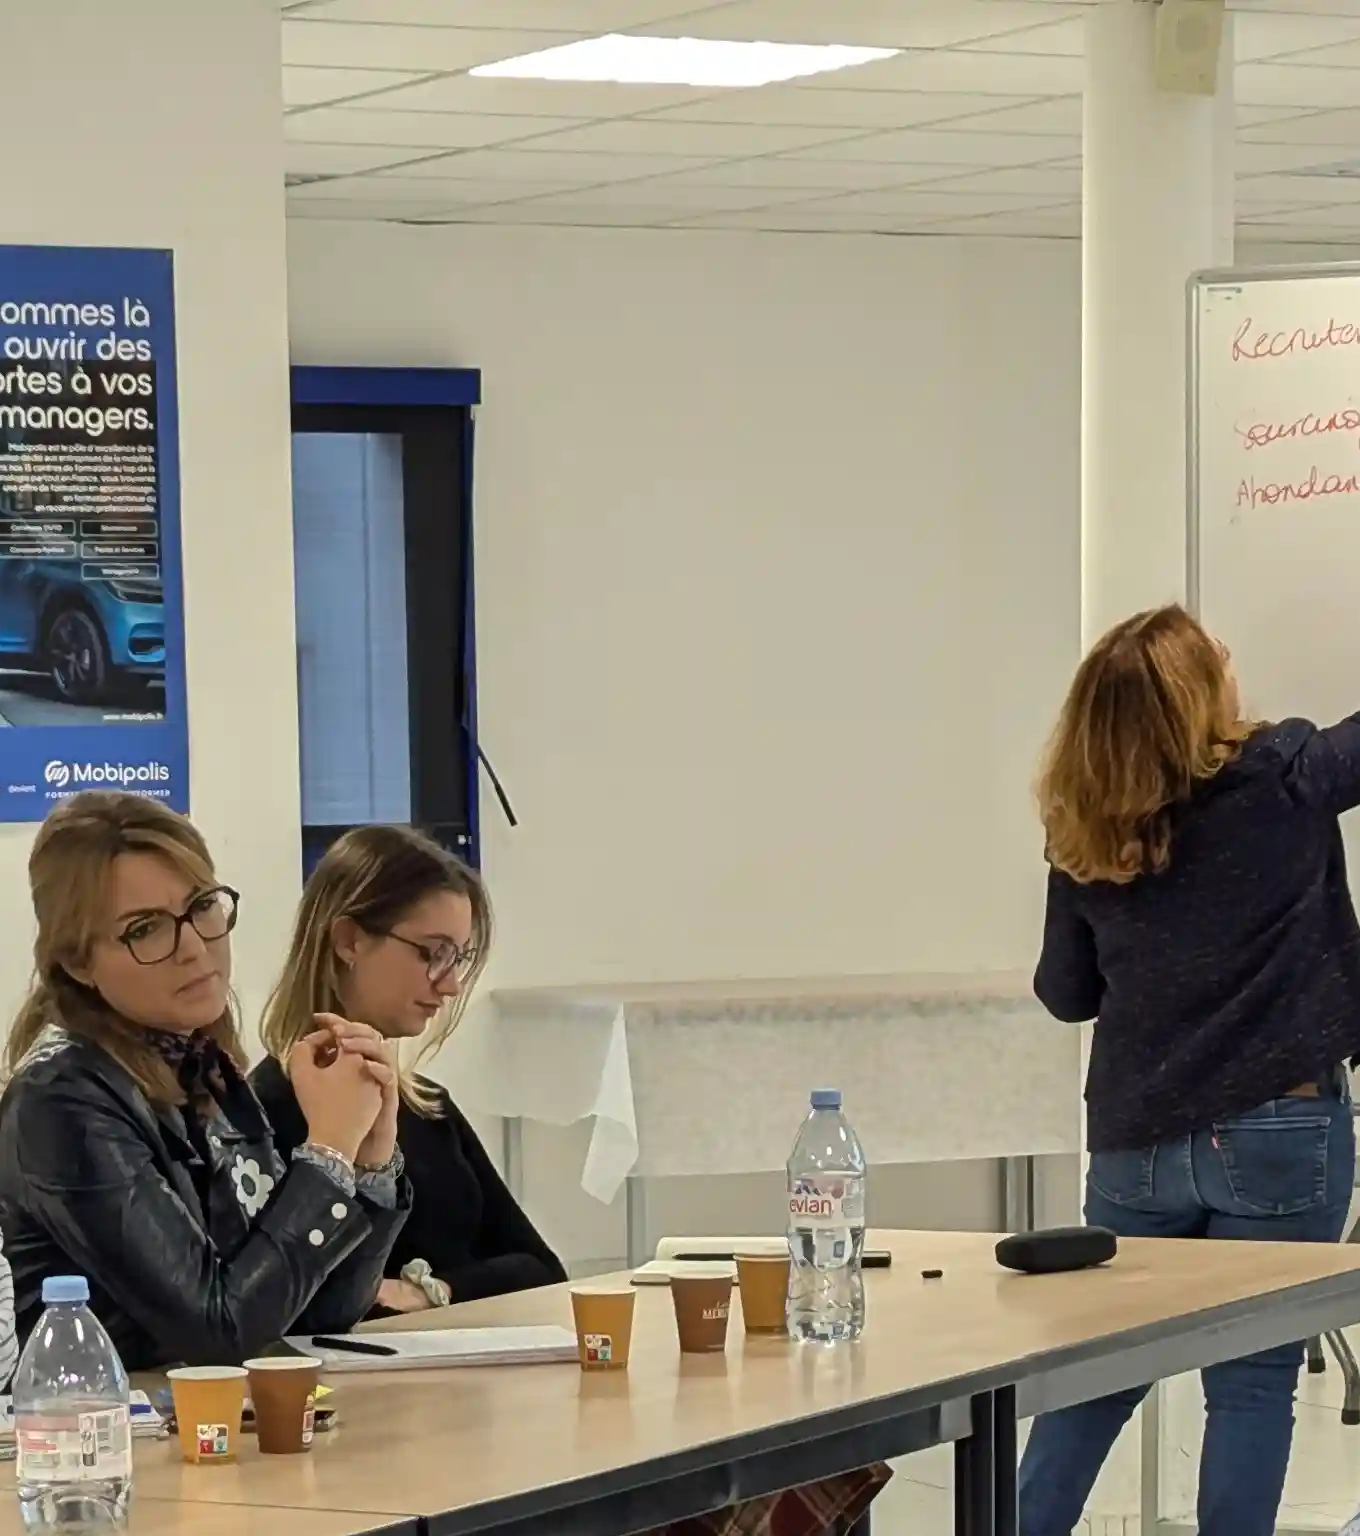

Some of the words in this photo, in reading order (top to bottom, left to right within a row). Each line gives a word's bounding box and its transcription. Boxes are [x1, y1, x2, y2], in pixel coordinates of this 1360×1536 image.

[123, 297, 151, 328] là
[3, 331, 88, 361] ouvrir
[96, 331, 152, 362] des
[70, 366, 93, 395] à
[99, 372, 153, 397] vos
[73, 762, 170, 785] Mobipolis
